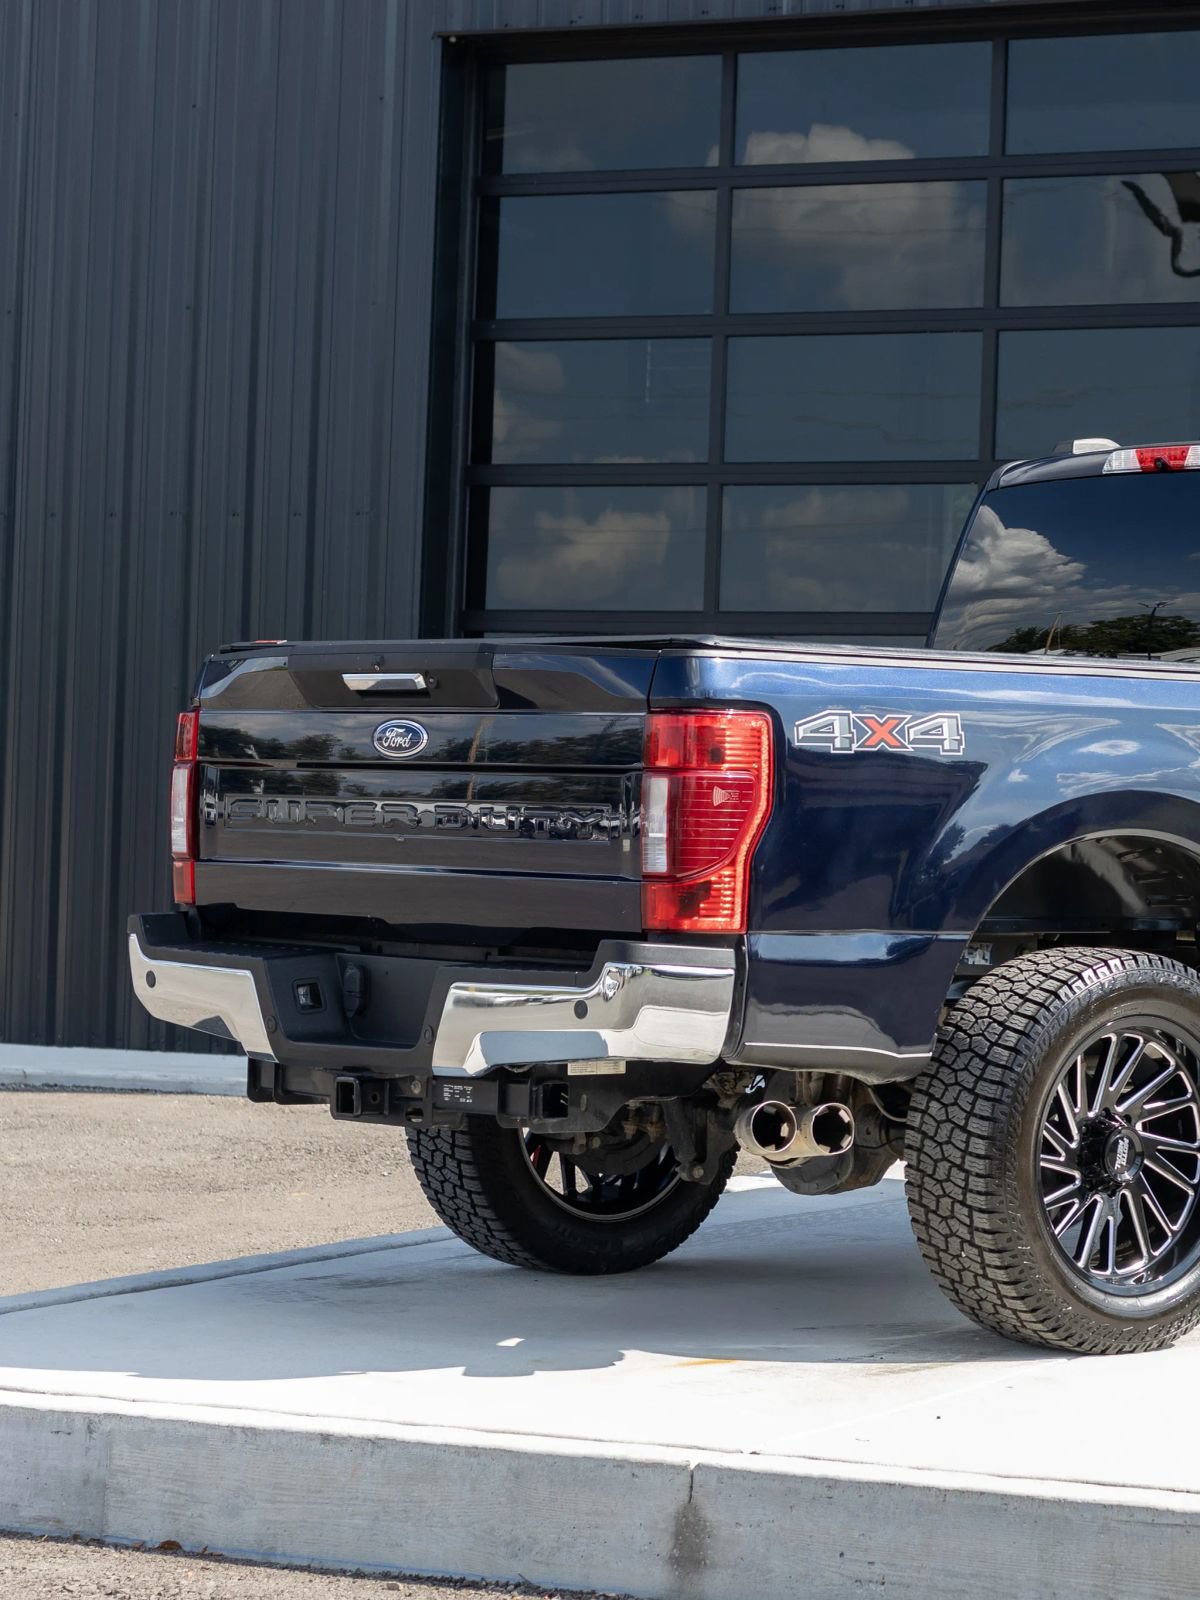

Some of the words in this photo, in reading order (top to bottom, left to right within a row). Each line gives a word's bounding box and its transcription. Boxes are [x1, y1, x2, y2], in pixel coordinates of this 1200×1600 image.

[383, 727, 412, 747] Ford
[229, 799, 419, 829] SUPER
[434, 804, 604, 840] DUTY
